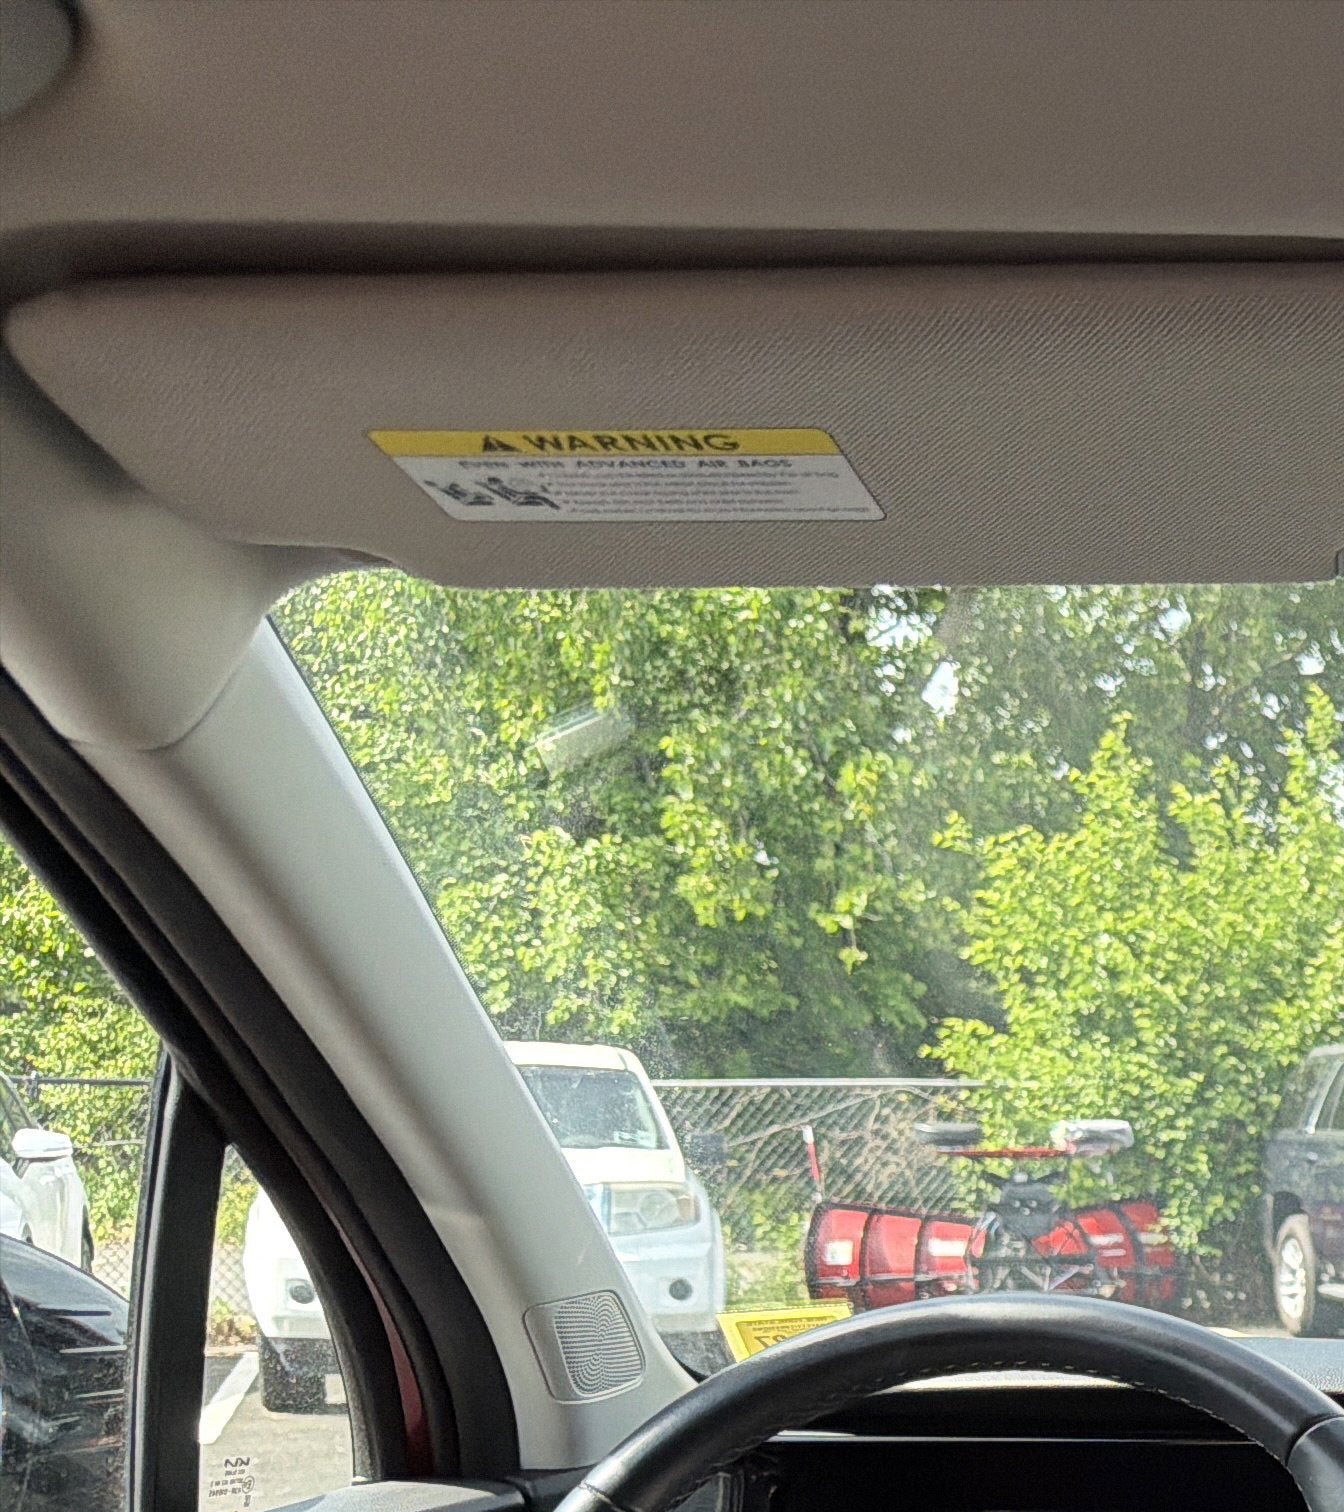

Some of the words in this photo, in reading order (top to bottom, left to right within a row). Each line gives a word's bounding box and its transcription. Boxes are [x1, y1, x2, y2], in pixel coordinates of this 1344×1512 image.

[522, 433, 740, 451] WARNING
[576, 459, 686, 468] ADVANCED
[699, 459, 729, 467] AIR
[737, 459, 792, 467] BAGS
